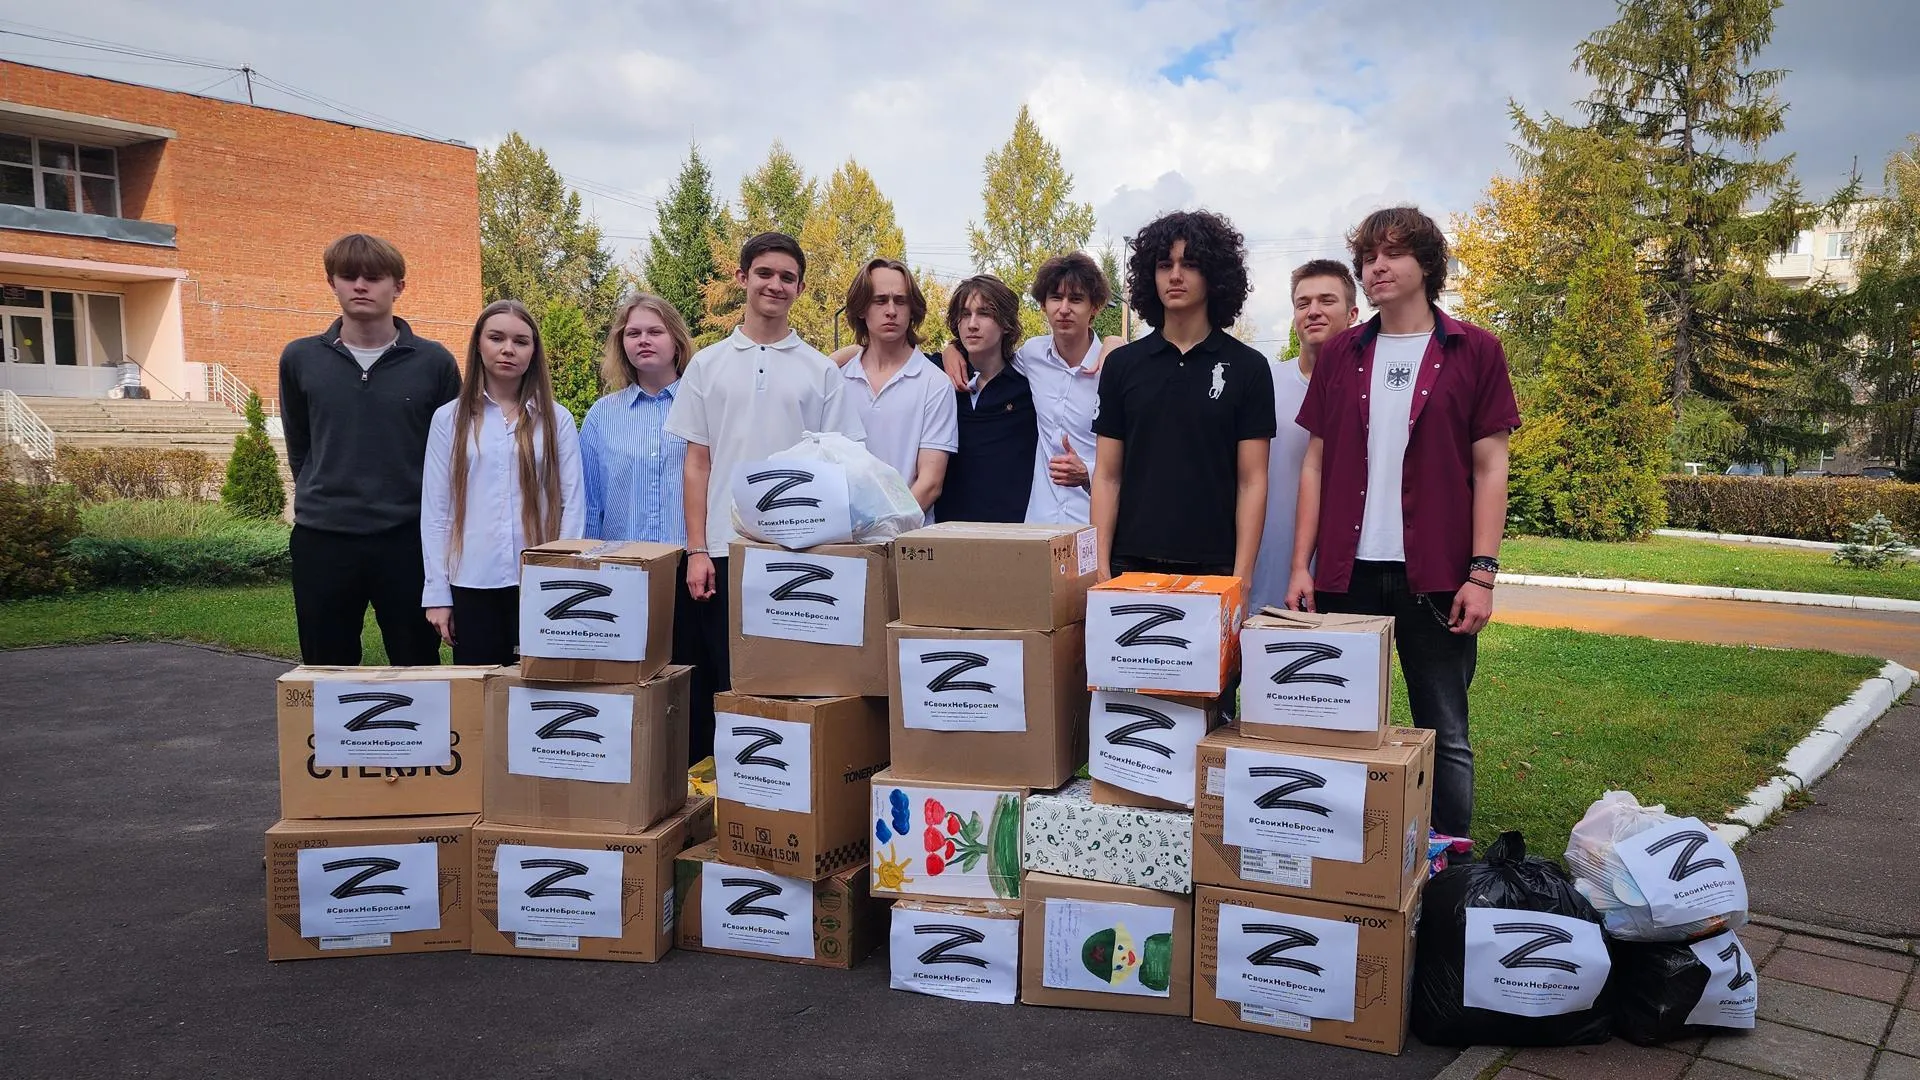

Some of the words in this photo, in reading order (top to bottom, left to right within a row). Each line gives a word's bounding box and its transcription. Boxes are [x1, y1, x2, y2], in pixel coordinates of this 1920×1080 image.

[765, 608, 840, 621] #СвоихНеБросаем
[540, 628, 620, 638] #СвоихНеБросаем
[1111, 655, 1193, 666] #СвоихНеБросаем
[286, 688, 314, 700] 30x4
[1266, 692, 1351, 704] #СвоихНеБросаем
[924, 701, 999, 709] #СвоихНеБросаем
[340, 739, 423, 747] #СвоихНеБросаем
[531, 746, 606, 759] #СвоихНеБросаем
[1099, 750, 1173, 775] #СвоихНеБросаем
[733, 771, 791, 787] #СвоихНеБросаем
[1249, 816, 1334, 834] #СвоихНеБросаем
[326, 905, 411, 914] #СвоихНеБросаем
[520, 905, 596, 916] #СвоихНеБросаем
[722, 923, 790, 936] #СвоихНеБросаем
[913, 972, 992, 984] #СвоихНеБросаем
[1242, 972, 1326, 994] #СвоихНеБросаем
[1493, 977, 1580, 991] #СвоихНеБросаем
